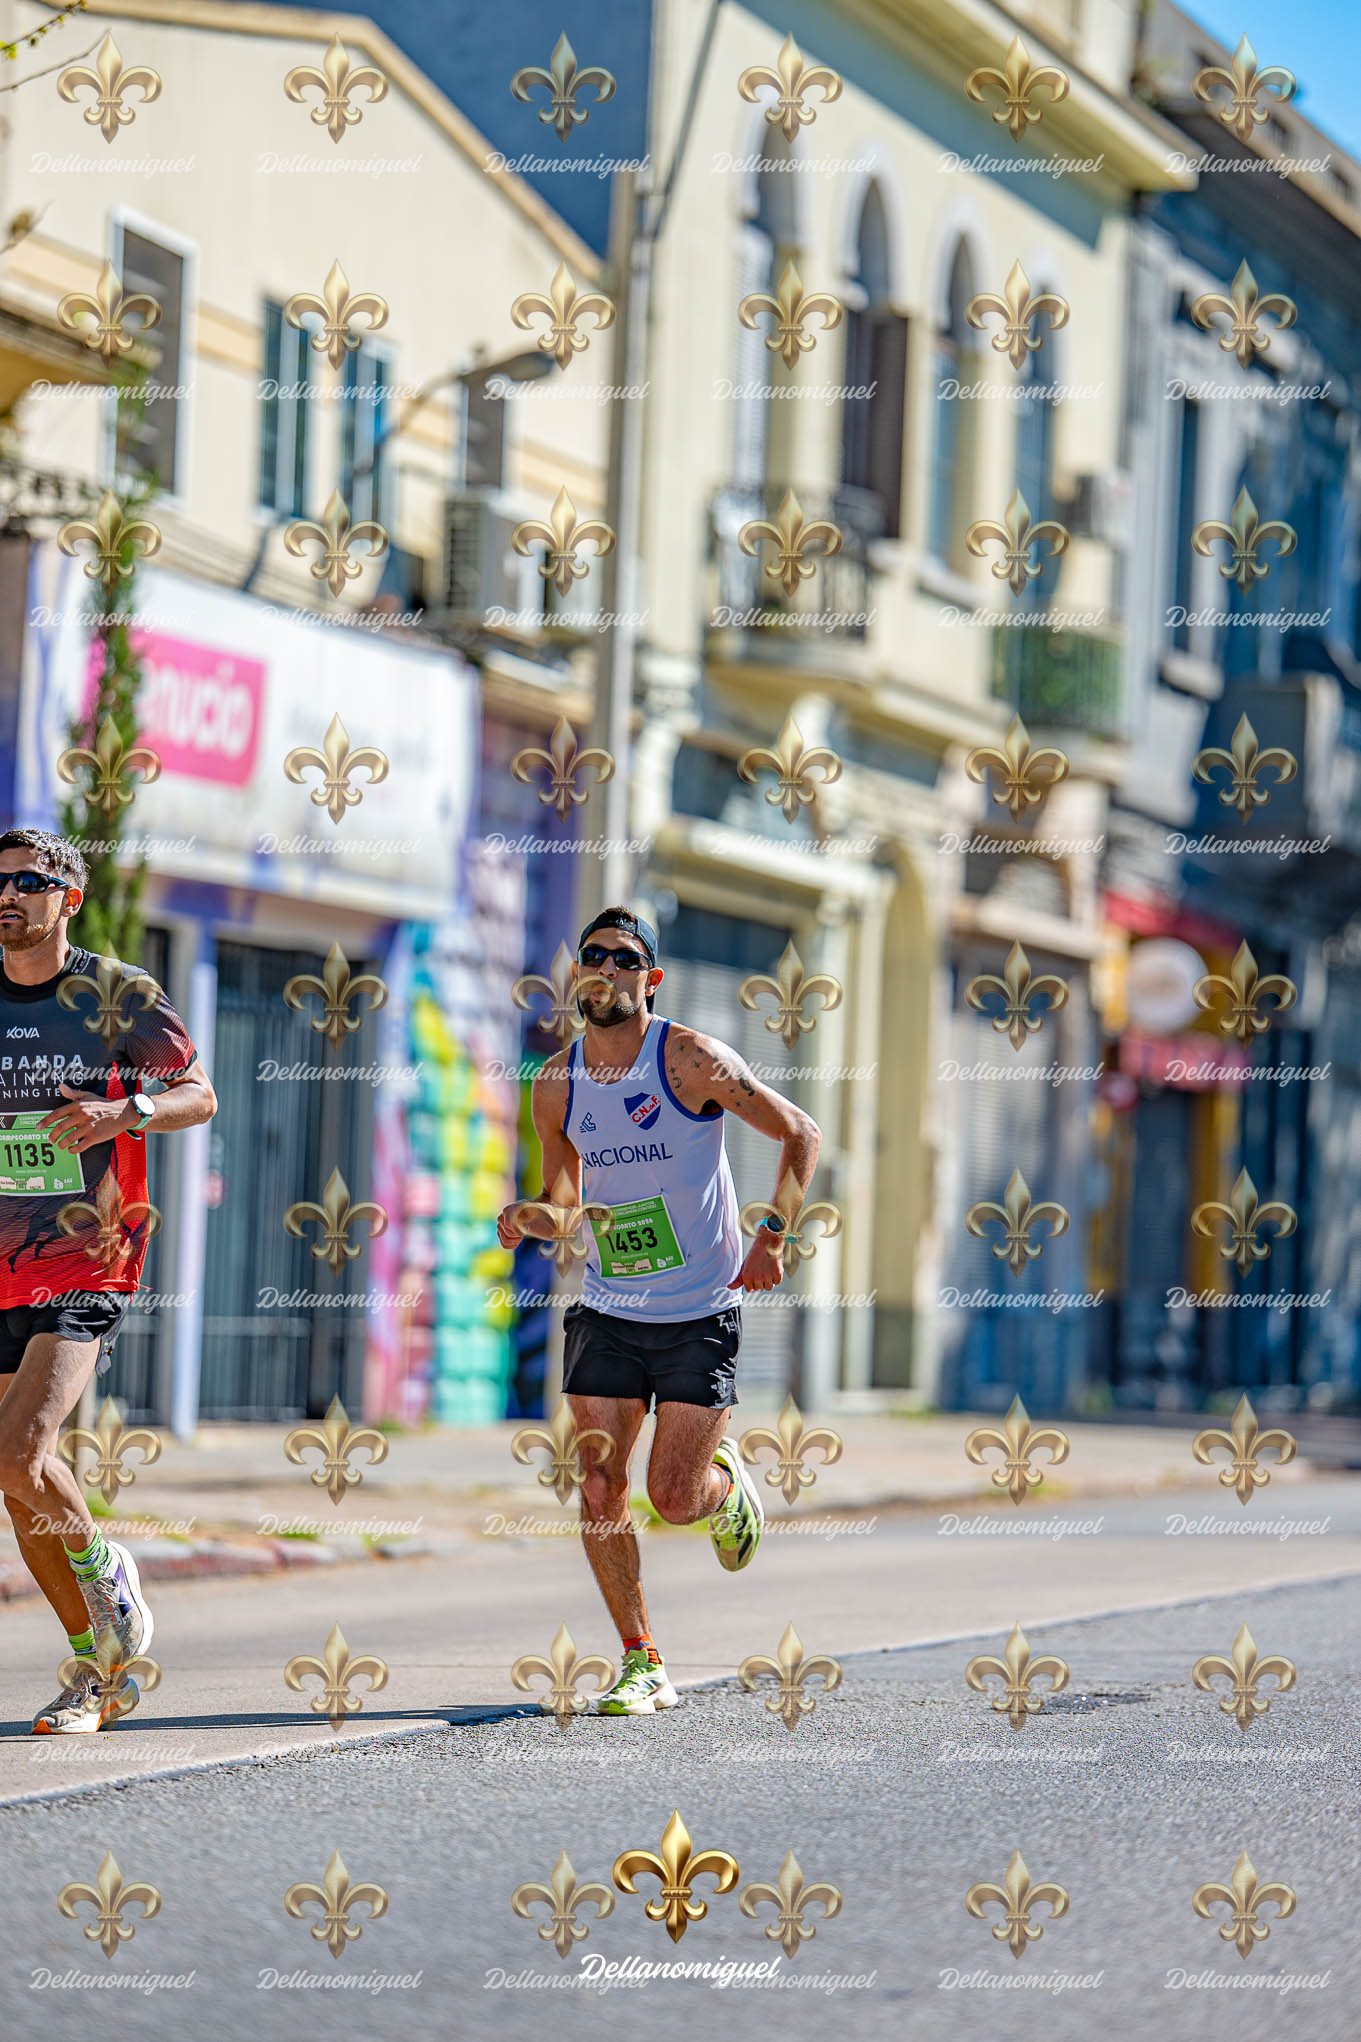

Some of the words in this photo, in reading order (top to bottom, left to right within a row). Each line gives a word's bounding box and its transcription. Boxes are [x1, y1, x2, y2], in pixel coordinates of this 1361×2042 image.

[6, 1026, 40, 1039] KOVA
[1, 1054, 84, 1070] BANDA
[4, 1142, 56, 1168] 1135
[581, 1142, 673, 1169] NACIONAL
[605, 1226, 659, 1254] 1453
